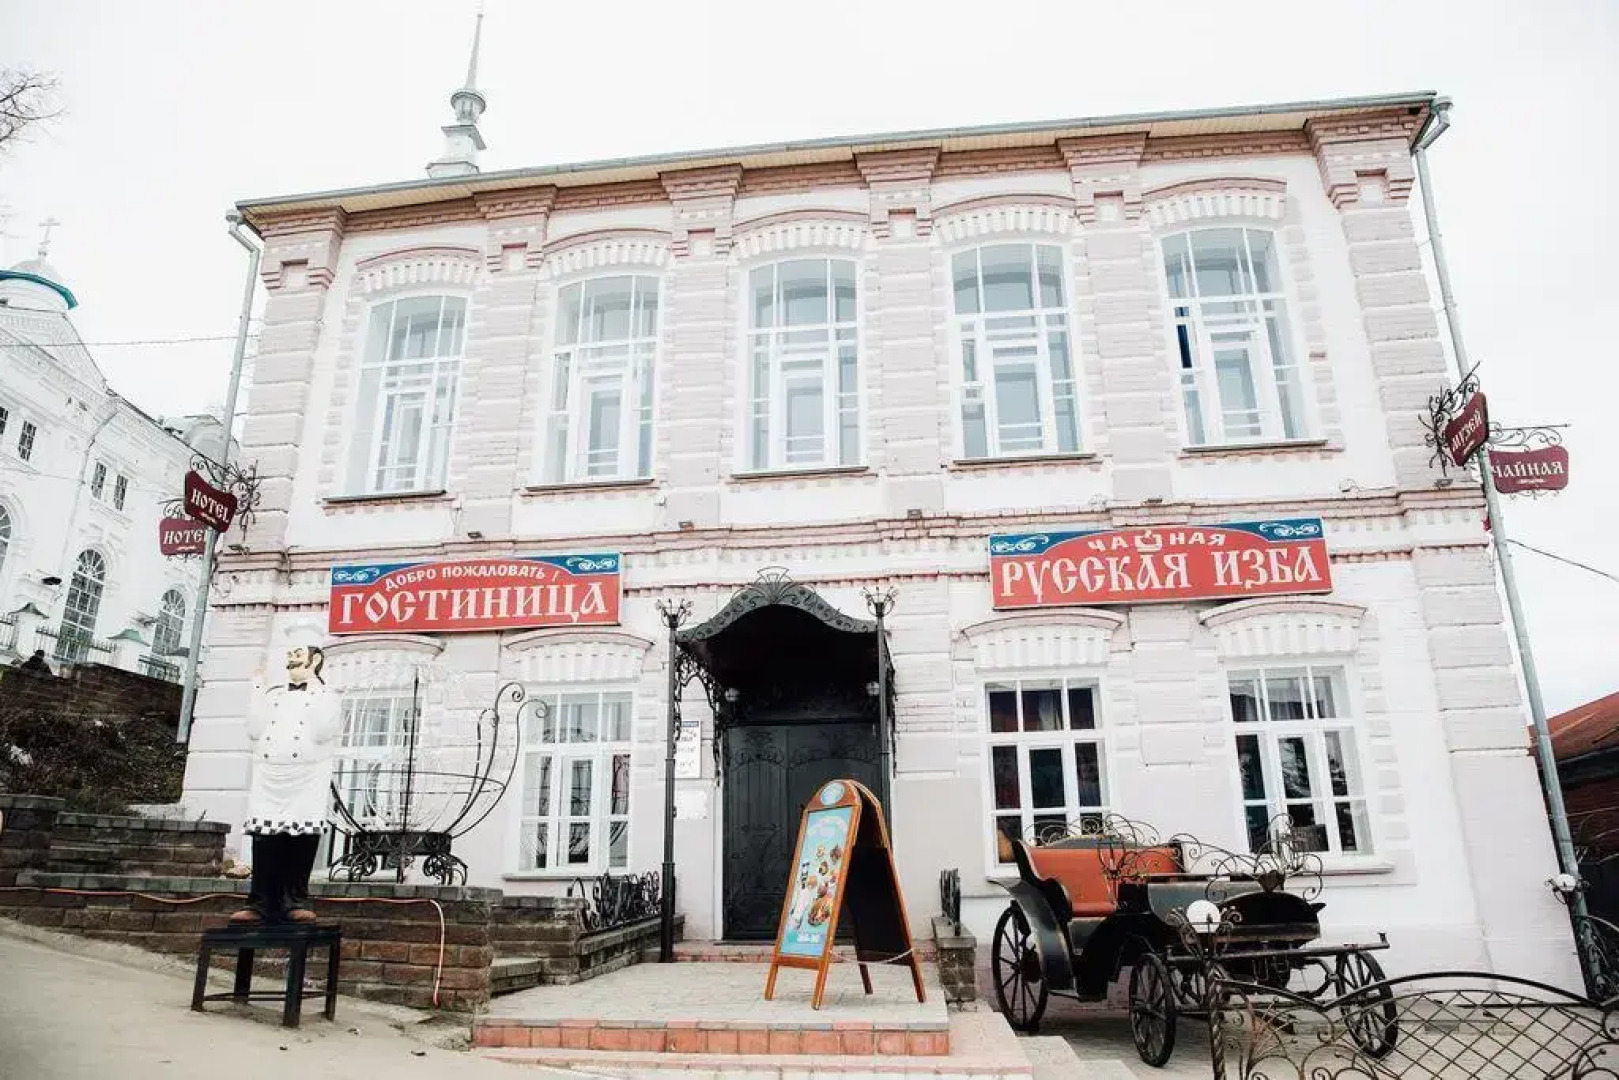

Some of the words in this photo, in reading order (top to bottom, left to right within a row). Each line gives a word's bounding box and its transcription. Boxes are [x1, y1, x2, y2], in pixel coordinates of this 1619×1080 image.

[1490, 460, 1564, 478] ЧАЙНАЯ
[191, 488, 229, 523] HOTEL
[163, 529, 204, 545] HOTE
[385, 568, 436, 592] ДОБРО
[442, 564, 545, 580] ПОЖАЛОВАТЬ
[1000, 553, 1193, 603] РУССКАЯ
[1211, 546, 1323, 589] ИЗБА
[339, 581, 608, 625] ГОСТИНИЦА
